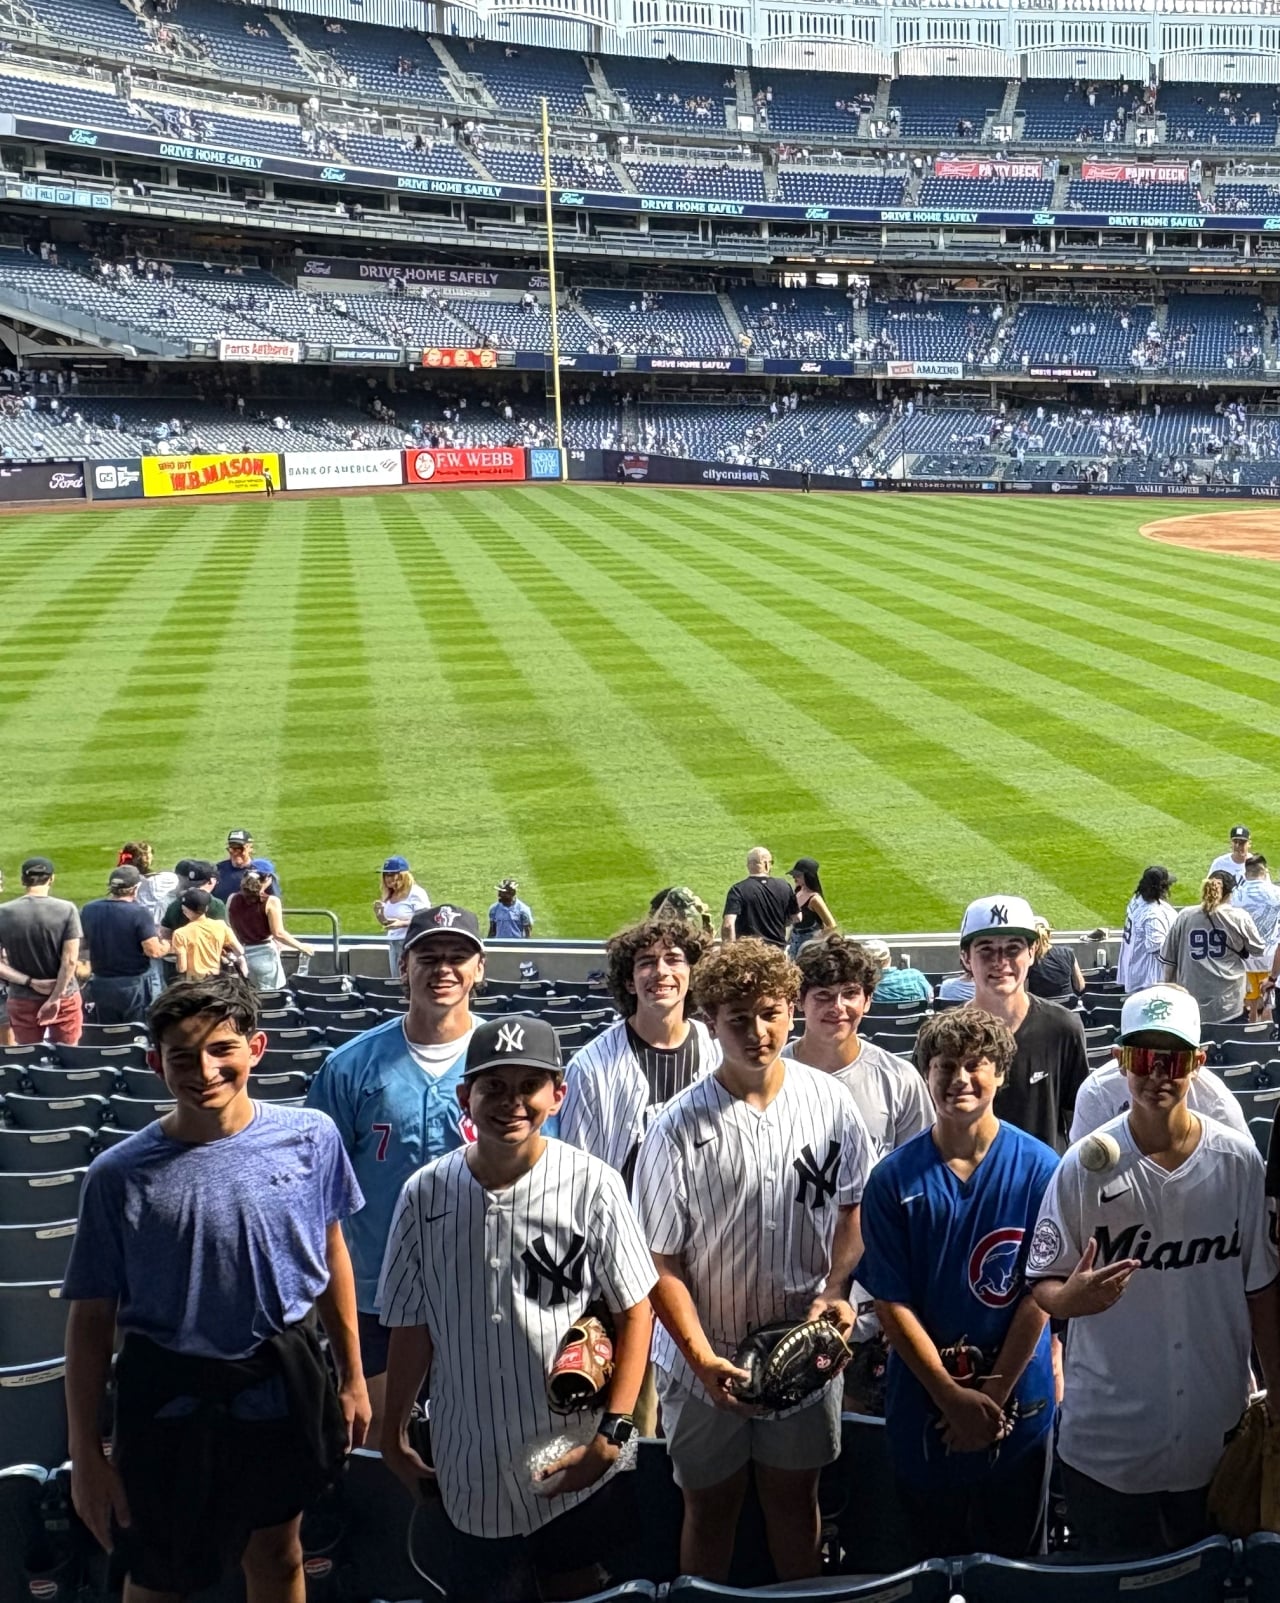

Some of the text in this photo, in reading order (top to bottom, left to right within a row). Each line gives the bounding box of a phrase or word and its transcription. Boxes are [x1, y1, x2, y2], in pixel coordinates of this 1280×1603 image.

[69, 128, 97, 145] Ford
[160, 143, 263, 169] DRIVE HOME SAFELY
[320, 167, 346, 182] Ford
[1012, 165, 1039, 178] DECK
[1158, 167, 1186, 180] DECK
[398, 177, 502, 197] DRIVE HOME SAFELY
[559, 192, 585, 205] Ford
[641, 200, 745, 215] DRIVE HOME SAFELY
[805, 208, 830, 220] Ford
[880, 212, 978, 223] DRIVE HOME SAFELY
[1032, 212, 1056, 225] Ford
[1108, 216, 1206, 228] DRIVE HOME SAFELY
[303, 260, 331, 275] Ford
[360, 264, 500, 286] DRIVE HOME SAFELY
[528, 275, 551, 289] For
[651, 359, 731, 370] DRIVE HOME SAFELY
[800, 362, 822, 372] Ford
[465, 452, 514, 467] WEBB
[288, 464, 379, 476] BANK OF AMERICA
[49, 472, 84, 489] Ford
[990, 903, 1009, 925] NY
[1189, 928, 1228, 961] 99
[495, 1023, 525, 1052] NY
[372, 1123, 393, 1162] 7
[793, 1140, 842, 1209] NY
[1092, 1218, 1242, 1272] Miami
[520, 1233, 587, 1306] NY
